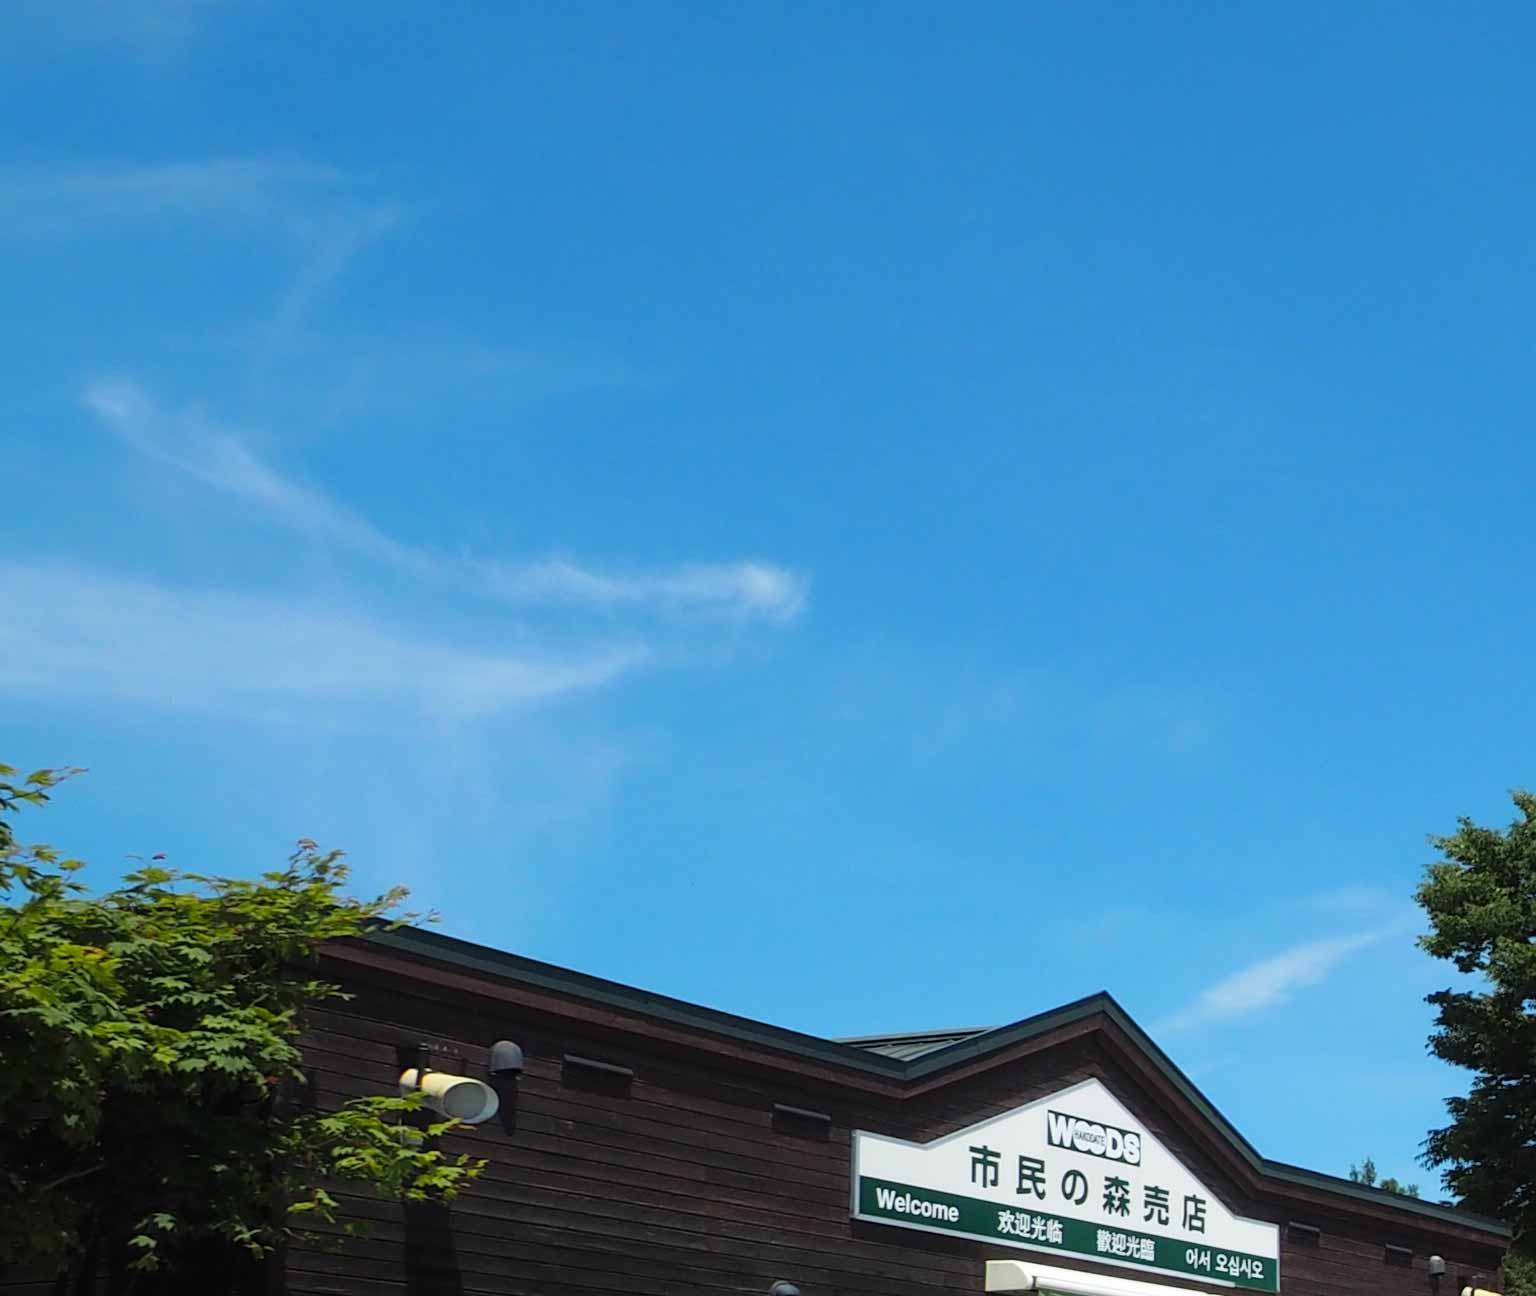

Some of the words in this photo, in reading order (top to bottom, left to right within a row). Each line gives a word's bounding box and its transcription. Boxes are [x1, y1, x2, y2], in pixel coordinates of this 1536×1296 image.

[1047, 1112, 1140, 1165] WOODS
[877, 1187, 959, 1222] Welcome
[968, 1144, 1207, 1234] 市民の森売店
[997, 1210, 1063, 1246] 欢迎光临
[1096, 1229, 1155, 1262] 歡迎光臨
[1185, 1247, 1211, 1272] 어서
[1215, 1252, 1264, 1281] 오십시오
